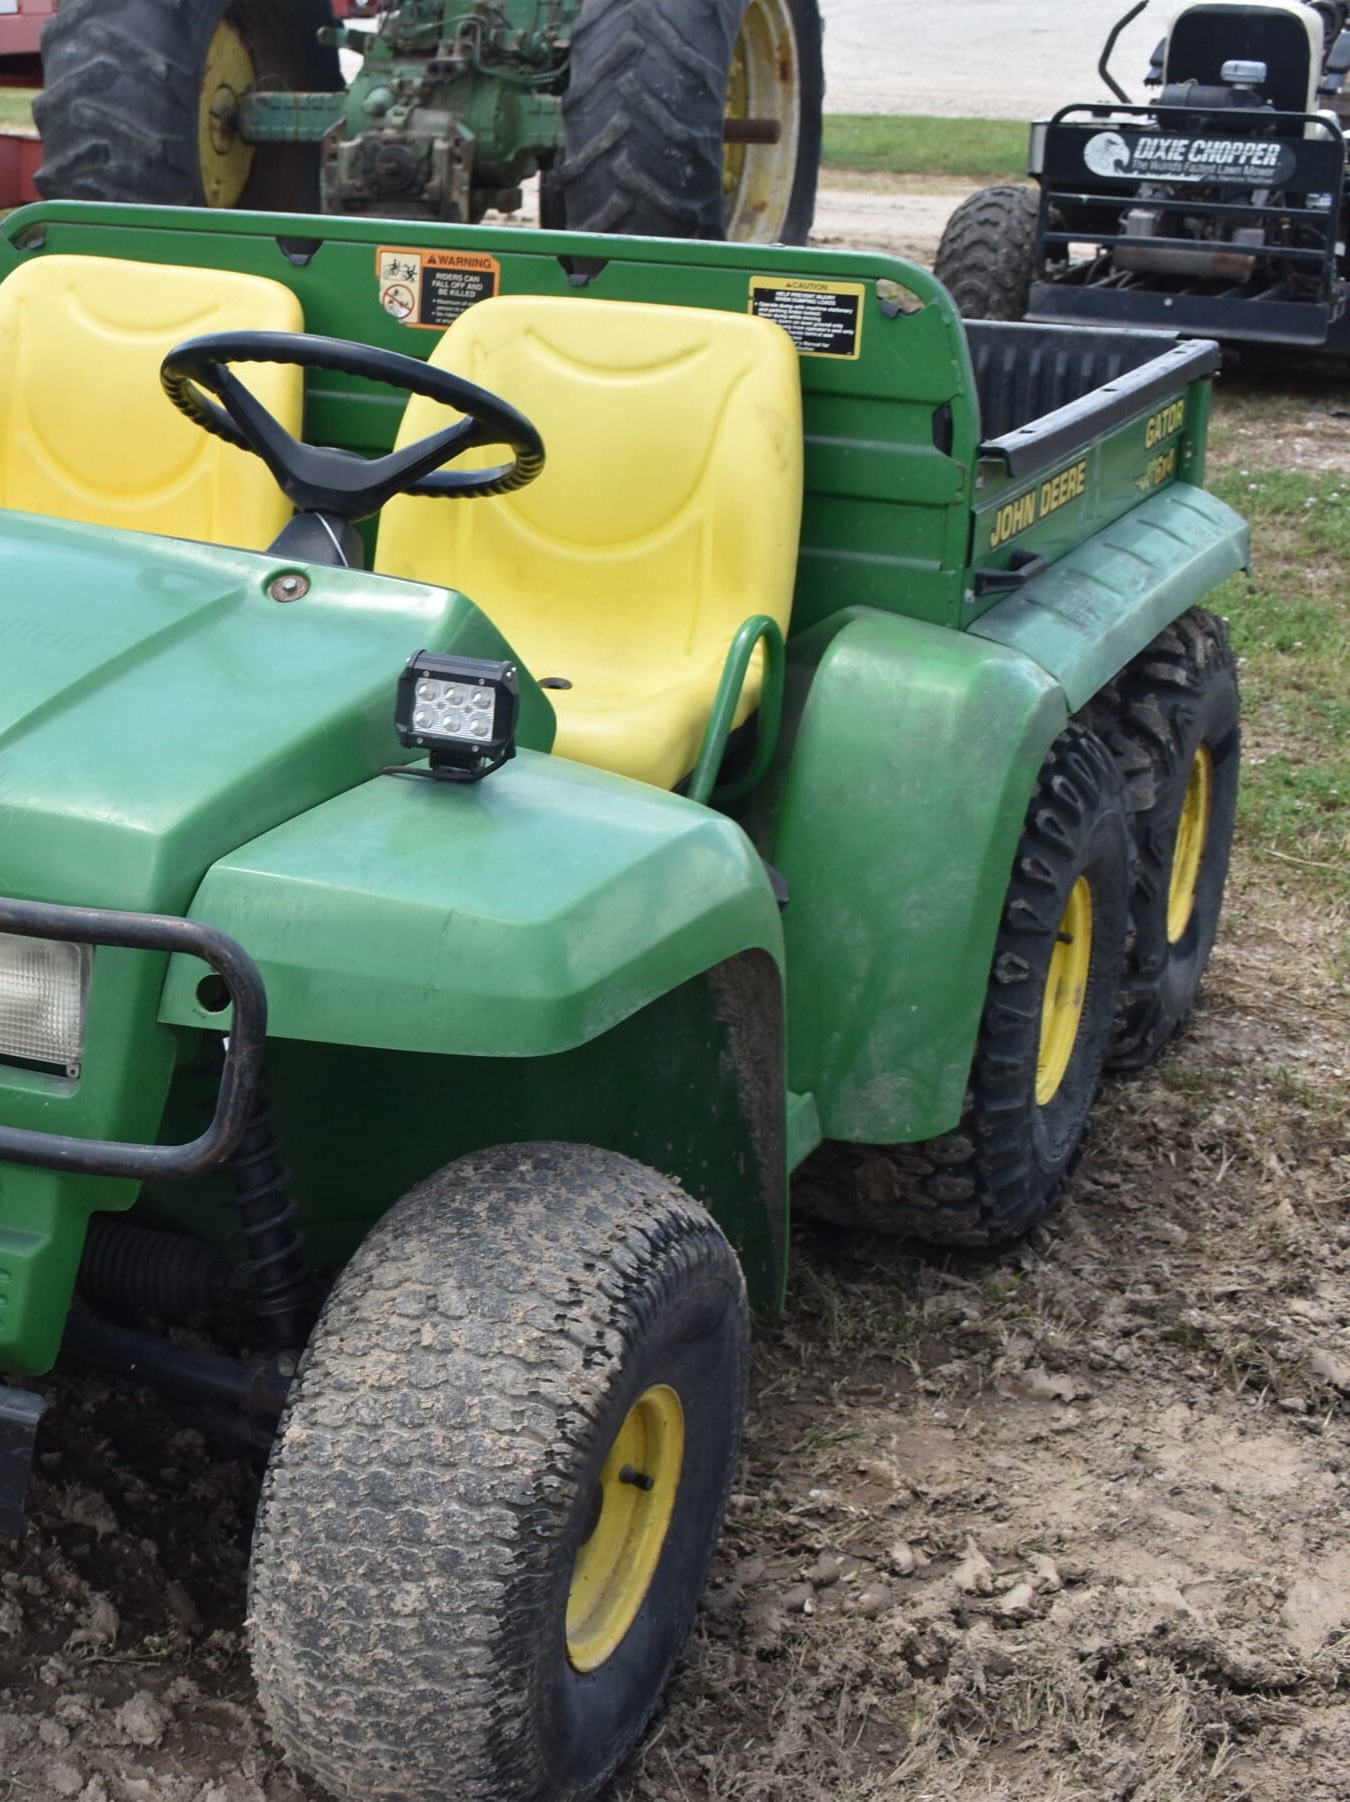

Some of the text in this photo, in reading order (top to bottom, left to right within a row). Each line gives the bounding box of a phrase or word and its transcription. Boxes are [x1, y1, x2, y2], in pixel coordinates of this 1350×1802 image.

[1134, 137, 1282, 166] DIXIE CHOPPER
[1132, 159, 1148, 170] The
[1244, 165, 1275, 177] Mower
[439, 256, 492, 268] WARNING
[435, 272, 480, 283] RIDERS CAN
[431, 280, 483, 291] FALL OFF AND
[437, 288, 476, 298] BE KILLED
[1145, 400, 1185, 449] GATOR
[990, 459, 1087, 547] JOHN DEERE
